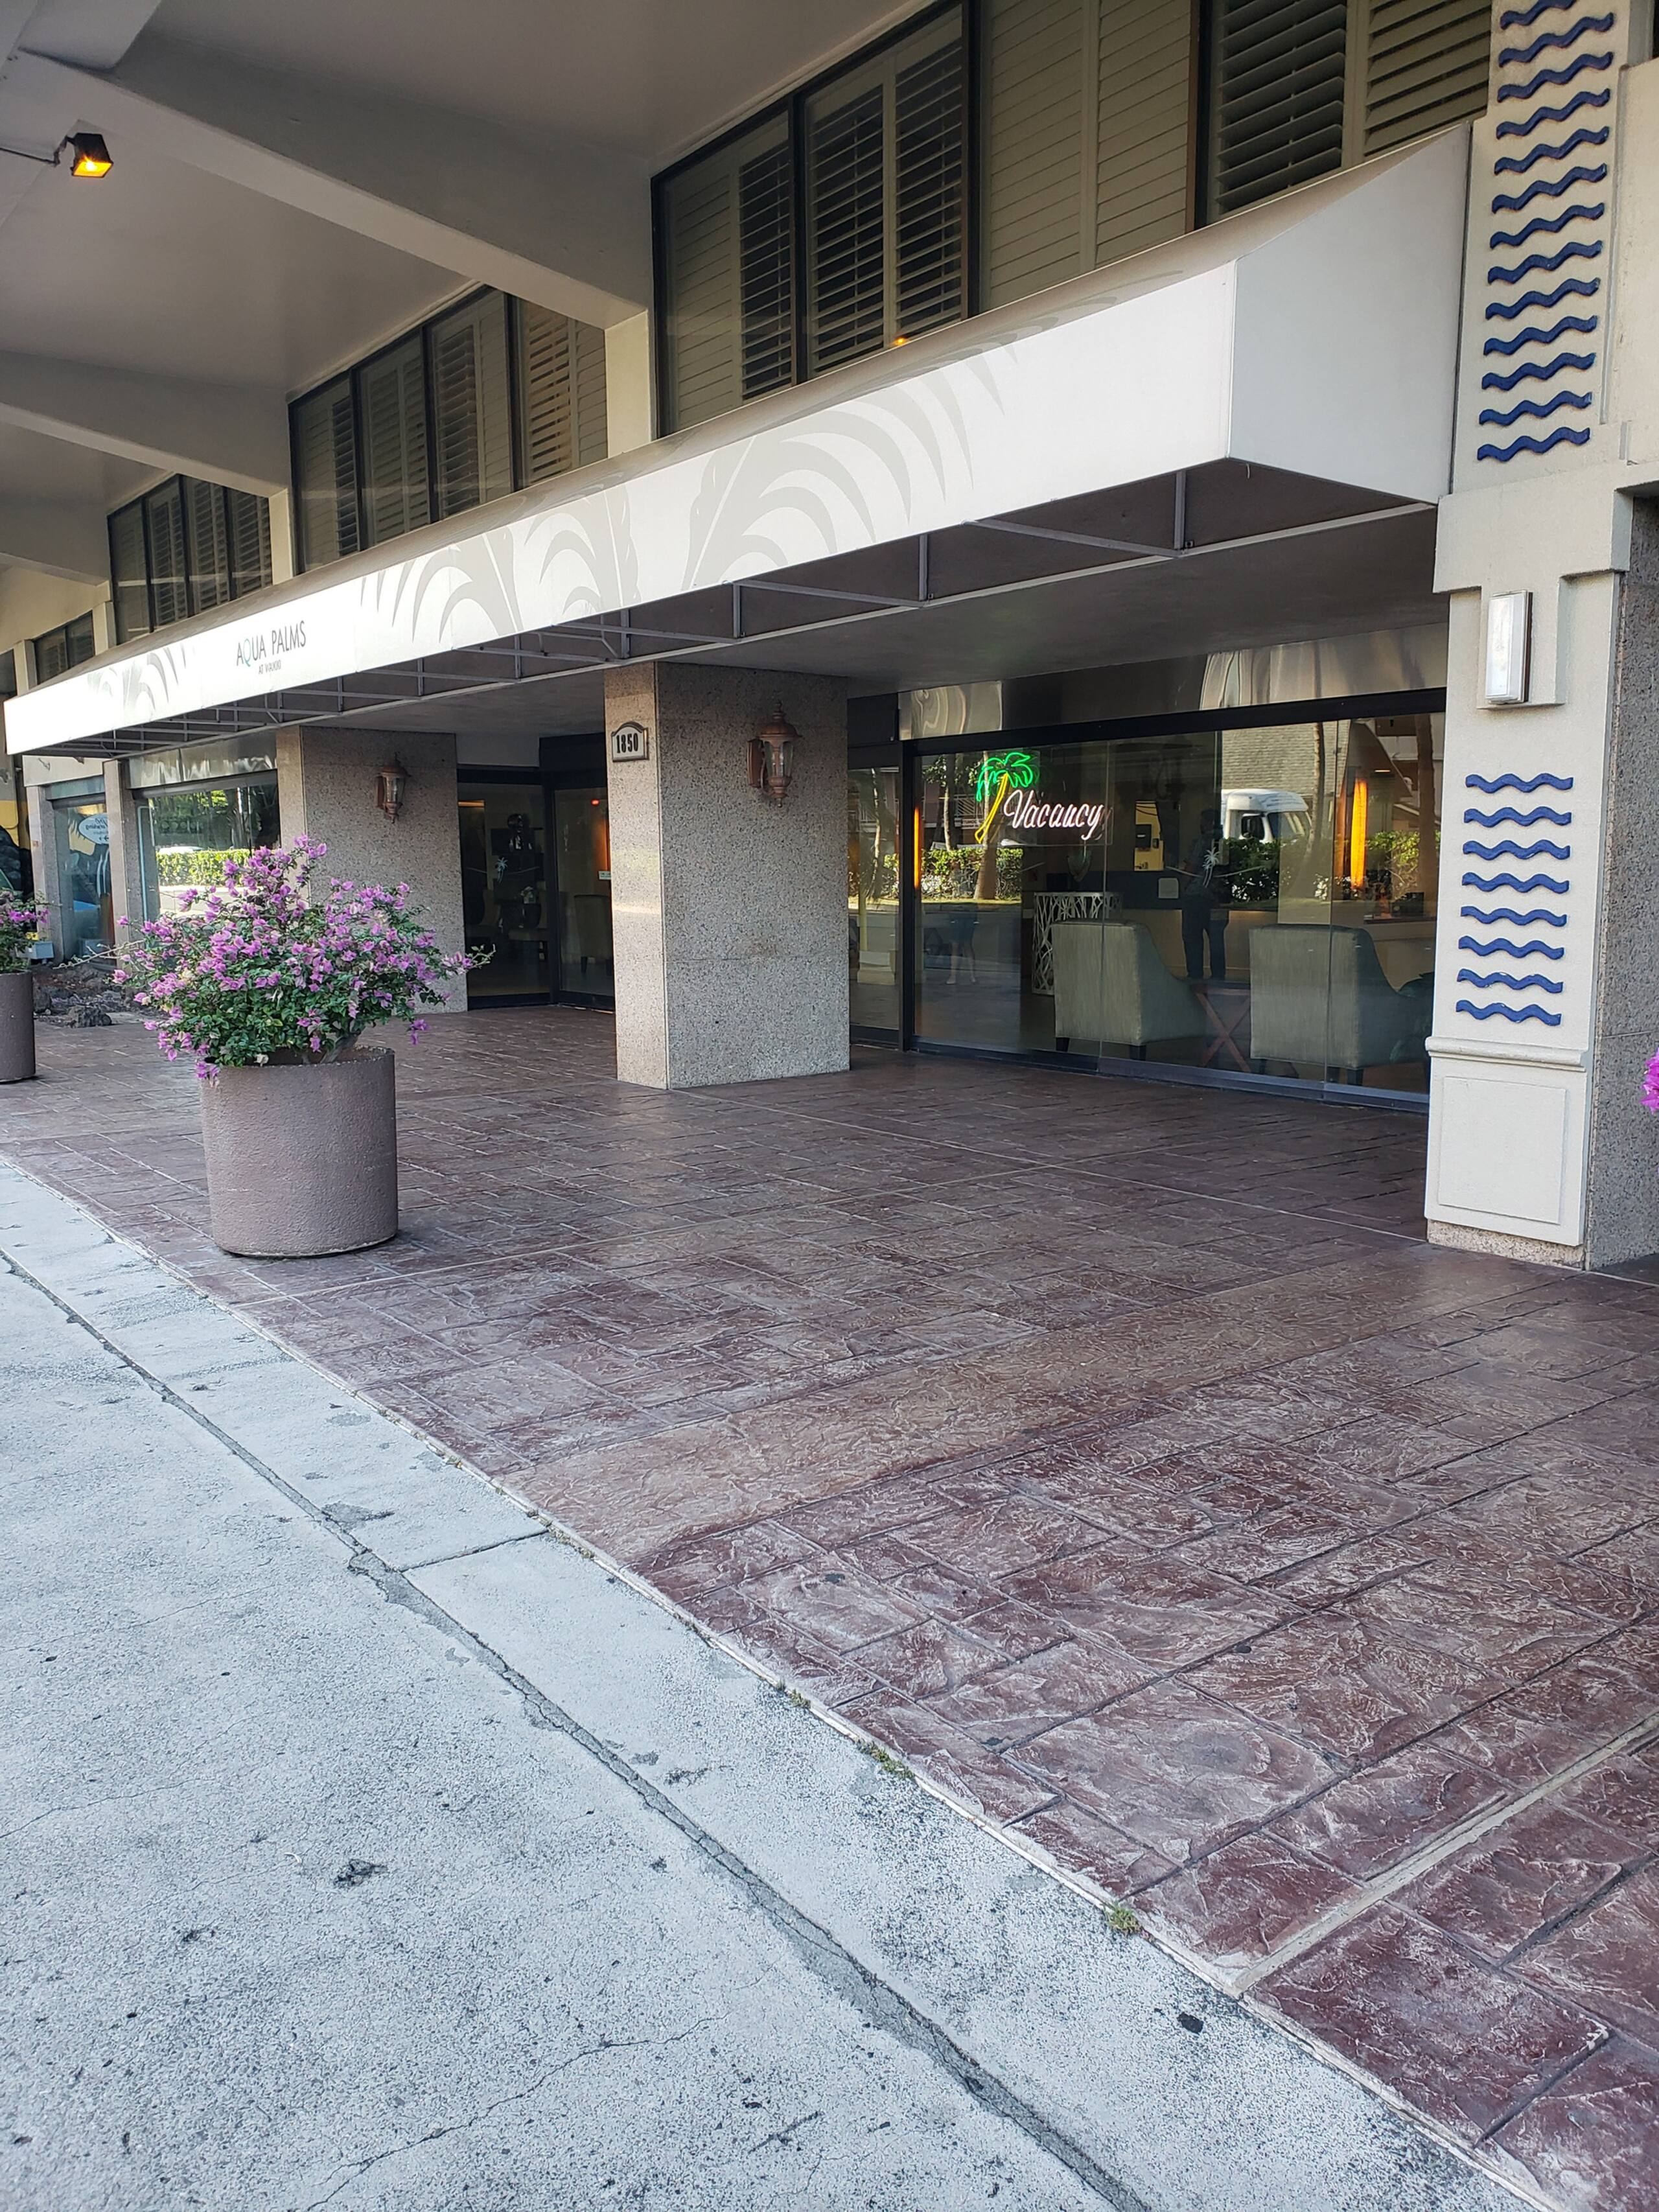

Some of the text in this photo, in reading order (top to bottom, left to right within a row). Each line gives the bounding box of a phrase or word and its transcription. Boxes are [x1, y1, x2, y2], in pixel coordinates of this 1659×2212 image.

[237, 620, 306, 667] AQUA PALMS
[616, 732, 638, 753] 1850
[1003, 789, 1104, 840] Vacancy
